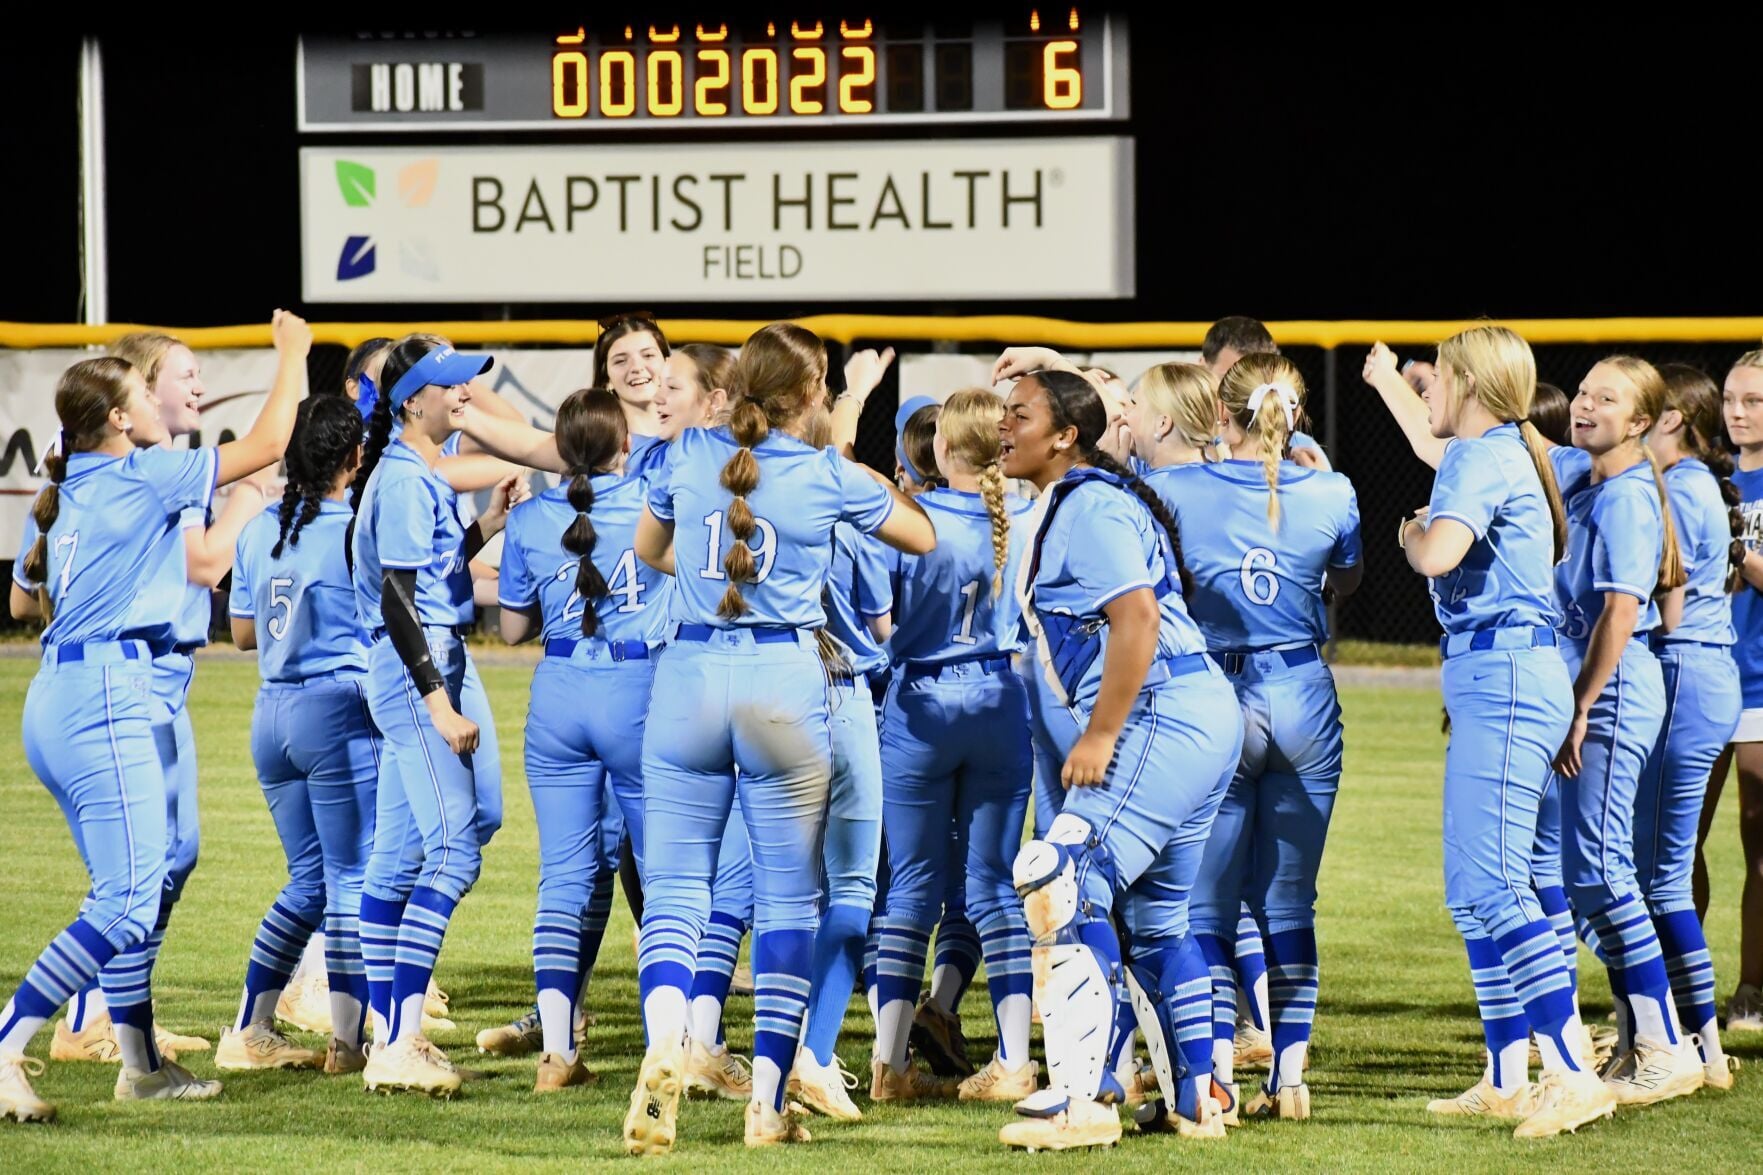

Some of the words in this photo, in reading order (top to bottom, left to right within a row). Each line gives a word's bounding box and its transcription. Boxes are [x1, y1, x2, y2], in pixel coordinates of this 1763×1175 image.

[370, 62, 464, 112] HOME
[1043, 40, 1082, 109] 6
[471, 174, 747, 234] BAPTIST
[772, 169, 1043, 231] HEALTH
[703, 244, 803, 280] FIELD
[54, 529, 80, 601] 7
[699, 509, 779, 585] 19
[1239, 546, 1281, 606] 6
[266, 576, 295, 642] 5
[556, 548, 646, 623] 24
[951, 579, 979, 645] 1
